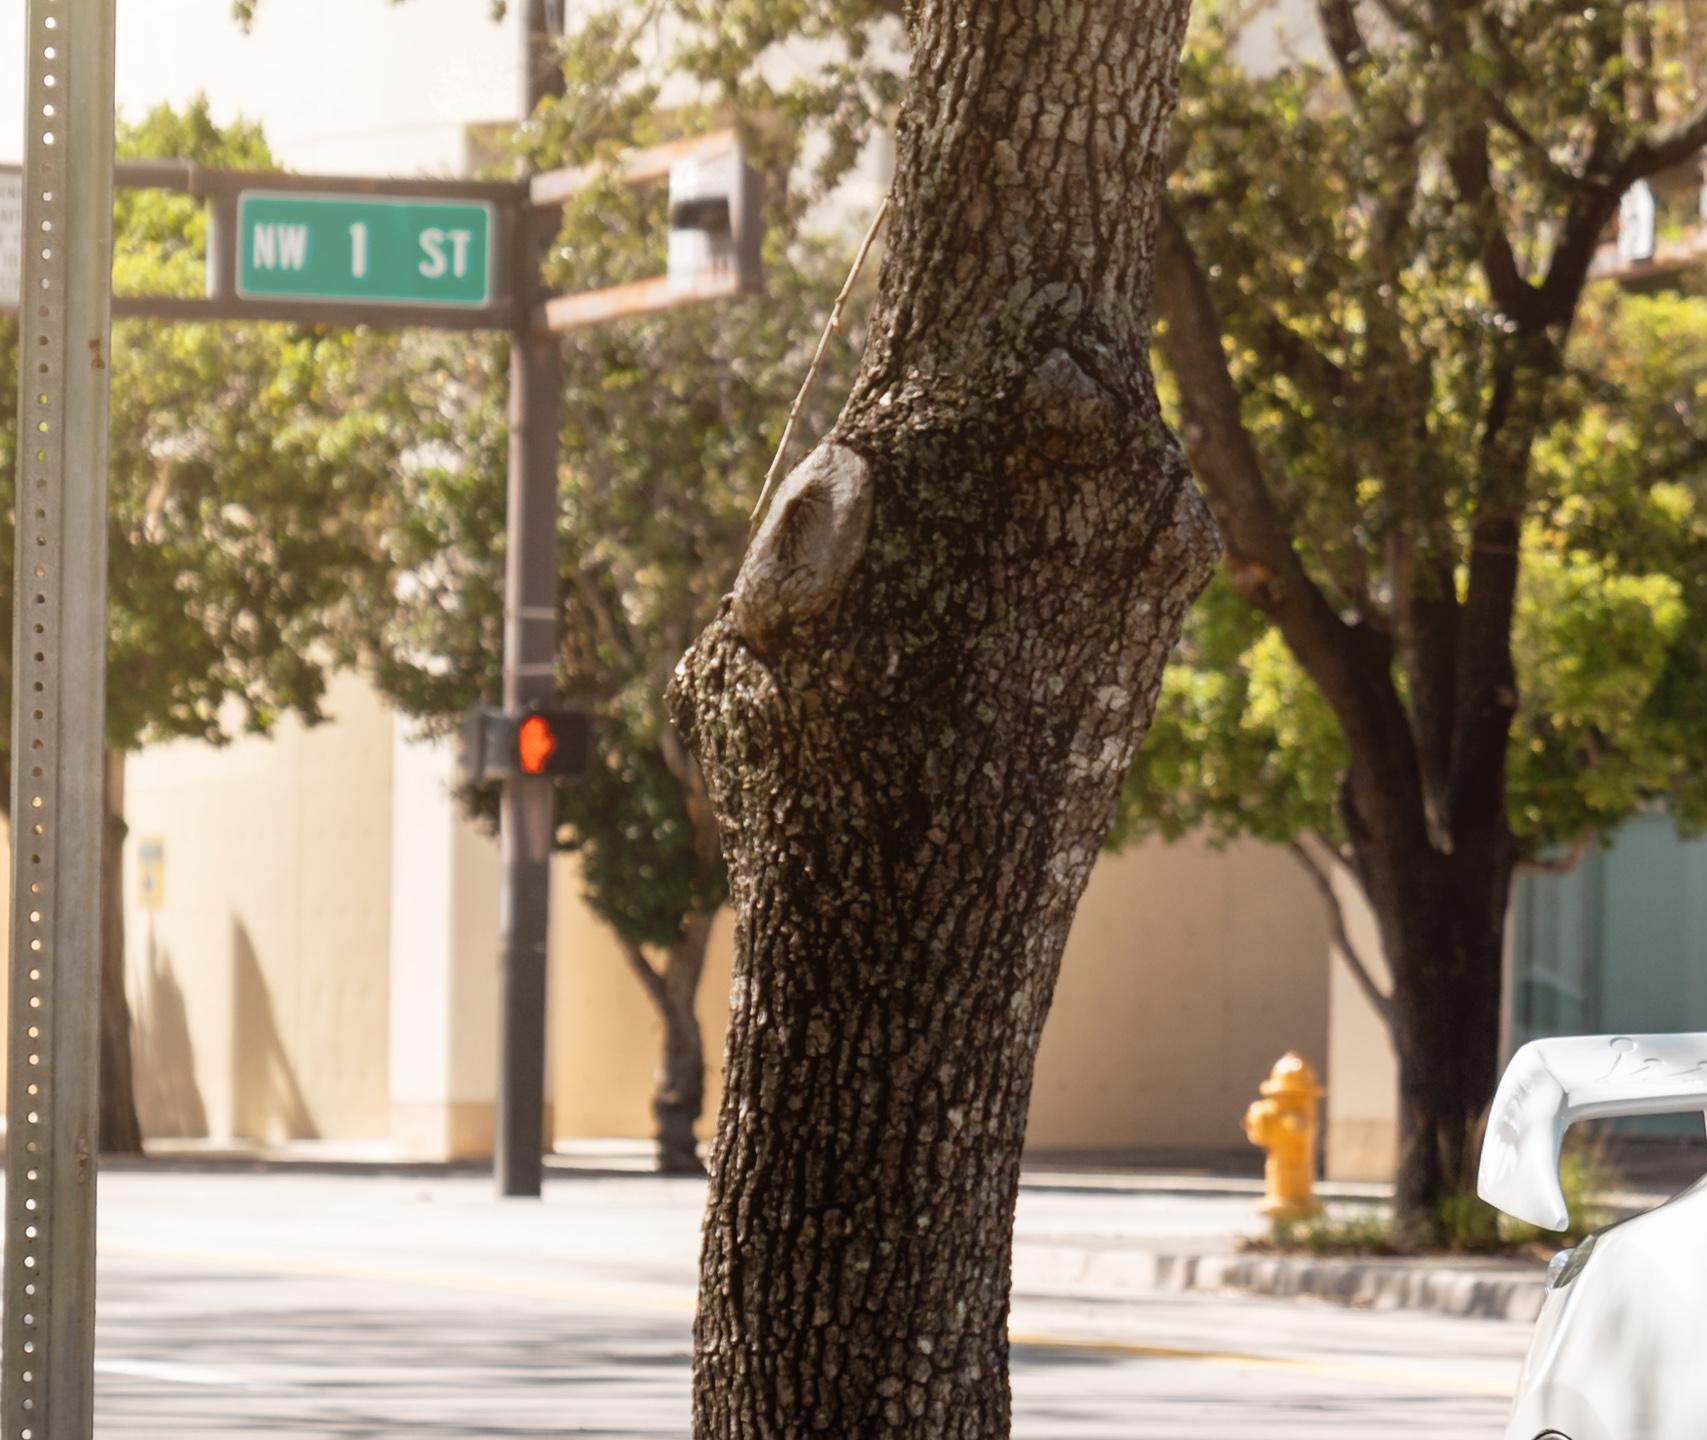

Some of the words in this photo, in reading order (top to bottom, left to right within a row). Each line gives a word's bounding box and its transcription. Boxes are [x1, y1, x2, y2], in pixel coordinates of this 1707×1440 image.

[253, 222, 308, 271] NW
[350, 221, 368, 278] 1
[418, 227, 472, 279] ST
